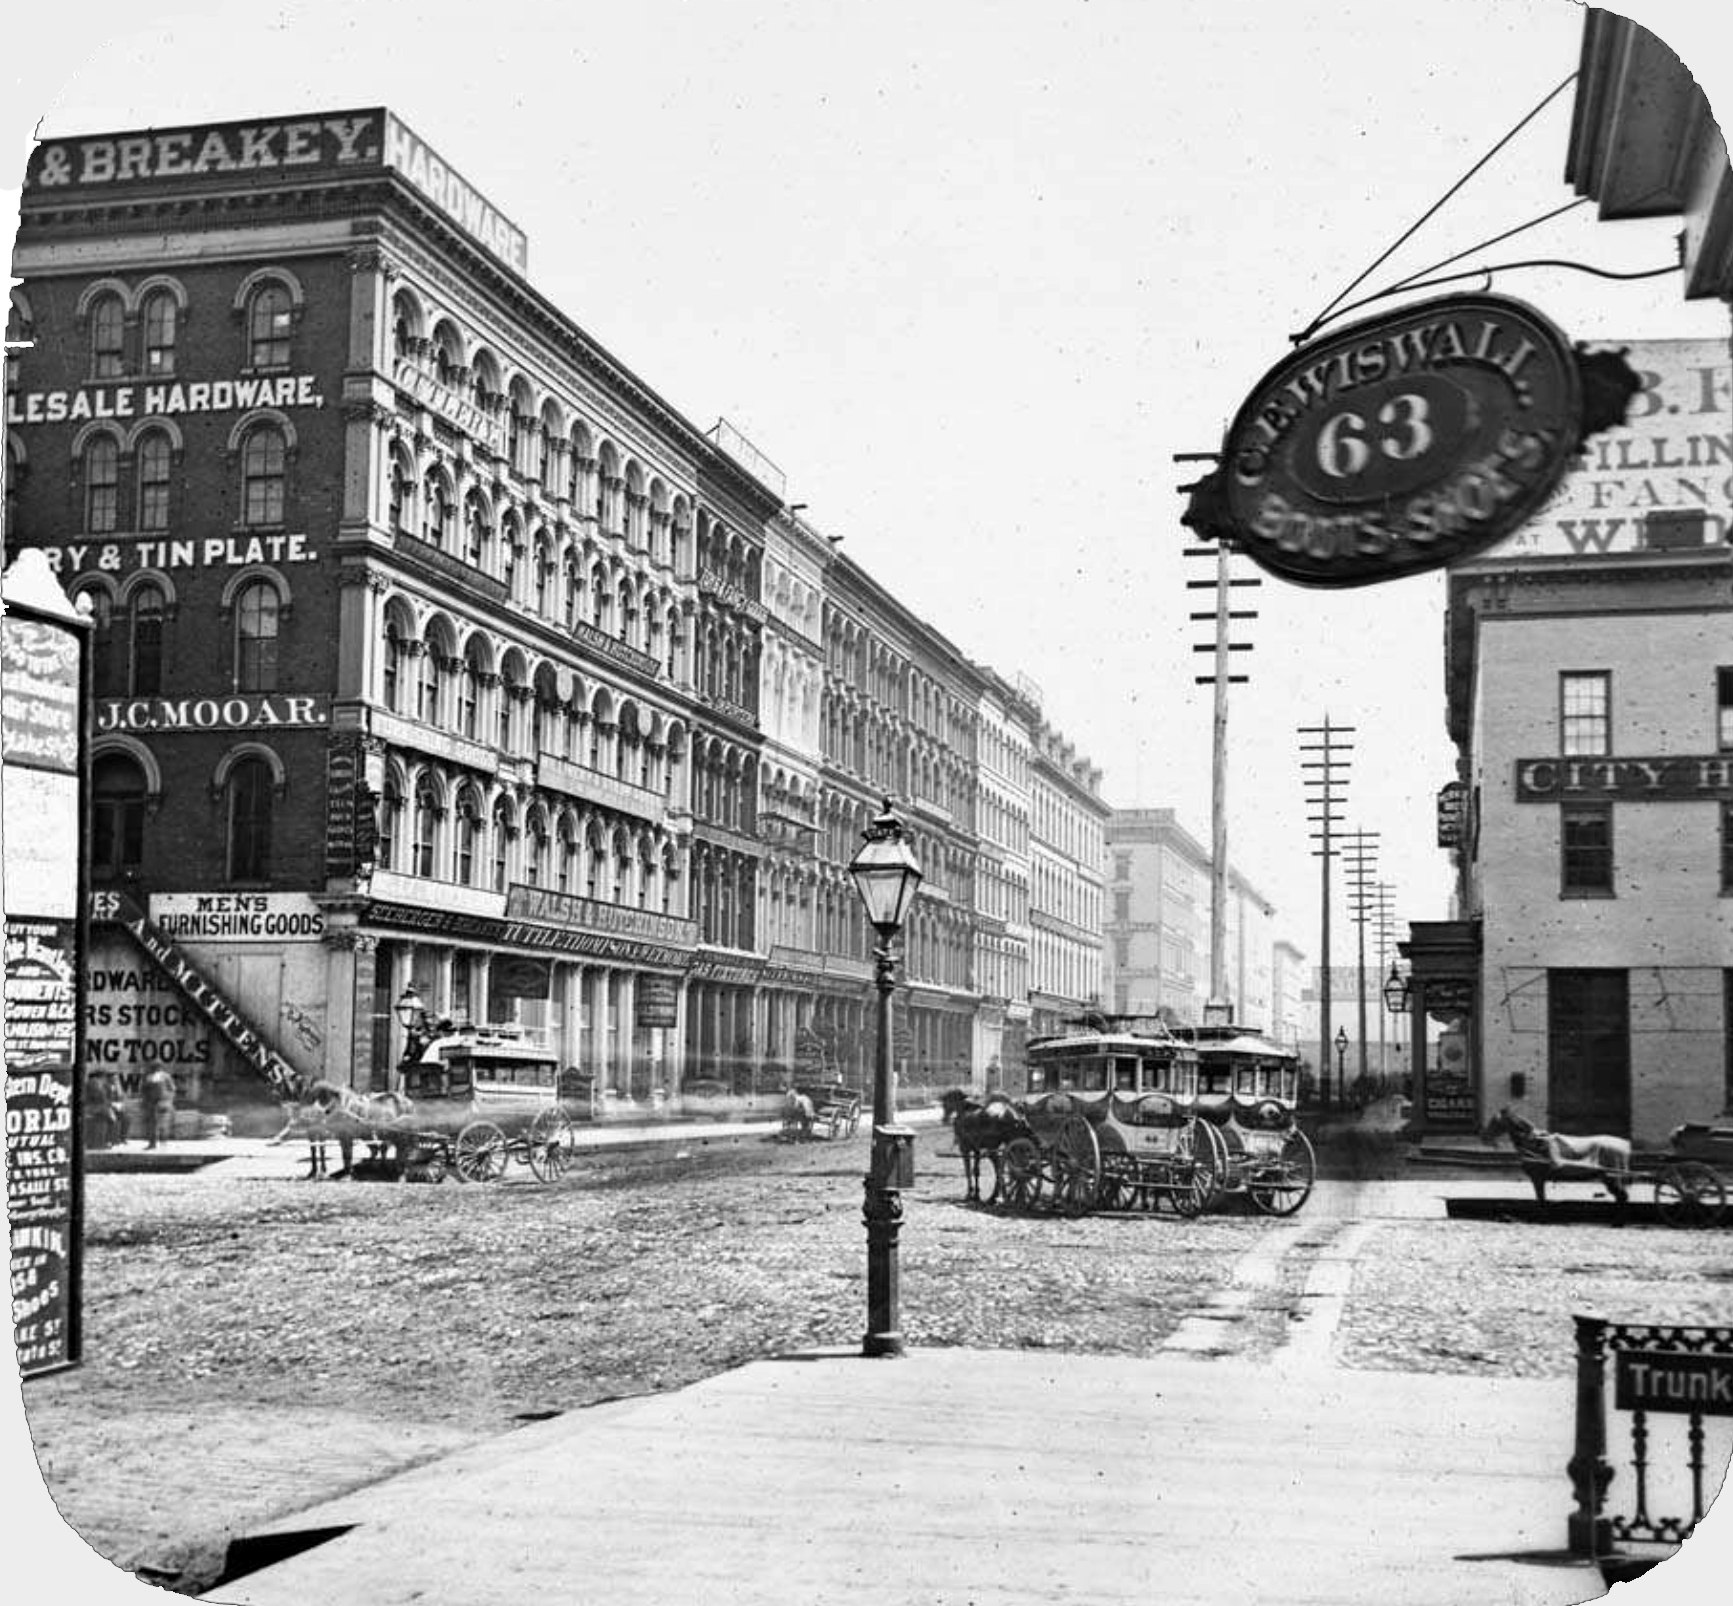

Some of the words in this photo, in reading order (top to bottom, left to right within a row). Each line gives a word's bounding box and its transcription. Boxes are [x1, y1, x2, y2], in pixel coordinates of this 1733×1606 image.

[39, 146, 71, 187] &
[79, 116, 378, 184] BREAKEY.
[387, 117, 527, 273] HARDWARE
[7, 385, 135, 424] LESALE
[145, 375, 325, 415] HARDWARE,
[1316, 393, 1433, 479] 63
[1567, 434, 1733, 472] ILLIN
[99, 544, 121, 570] &
[137, 540, 195, 568] TIN
[204, 534, 318, 567] PLATE.
[1521, 761, 1672, 793] CITY
[159, 913, 264, 937] FURNISHING
[265, 912, 325, 936] GOODS
[123, 1038, 210, 1064] TOOLS
[6, 1106, 72, 1134] ORLD
